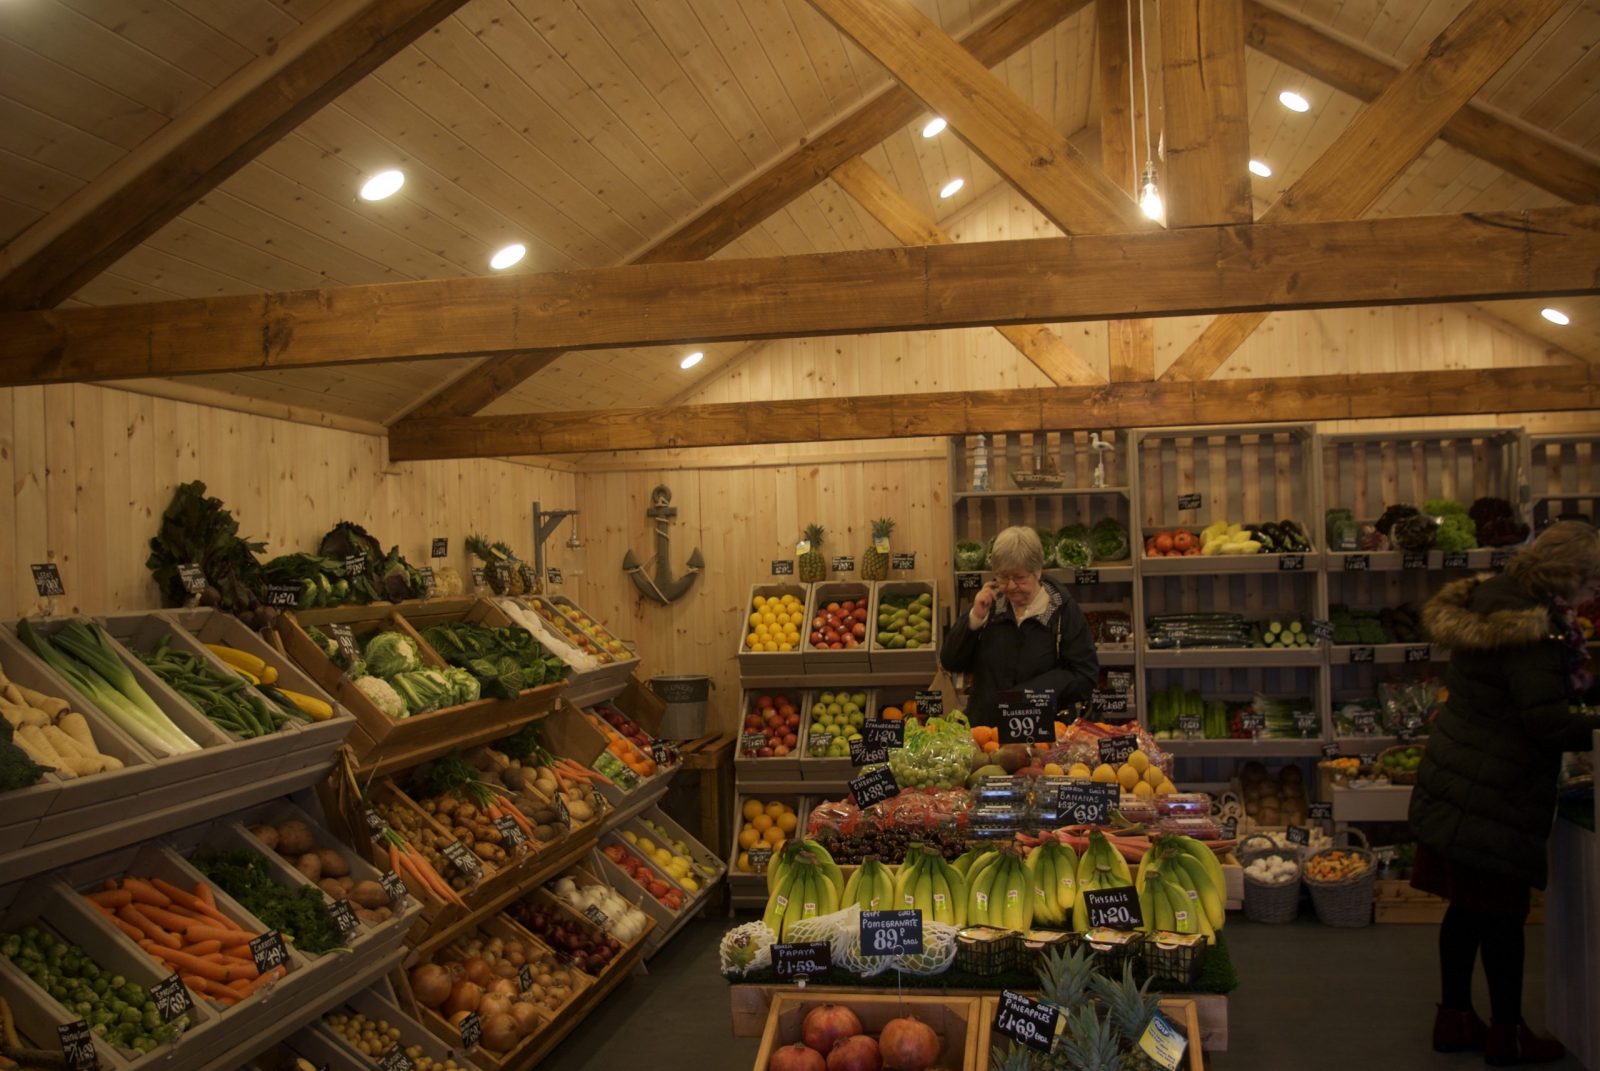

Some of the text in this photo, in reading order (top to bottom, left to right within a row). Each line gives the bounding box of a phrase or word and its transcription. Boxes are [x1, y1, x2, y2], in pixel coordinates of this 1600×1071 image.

[1060, 790, 1099, 803] BANANAS
[1089, 892, 1128, 904] PHYSALIS
[862, 918, 918, 928] POMEGRANATE
[779, 948, 816, 957] PAPAYA
[1005, 998, 1050, 1023] PINEAPPLES
